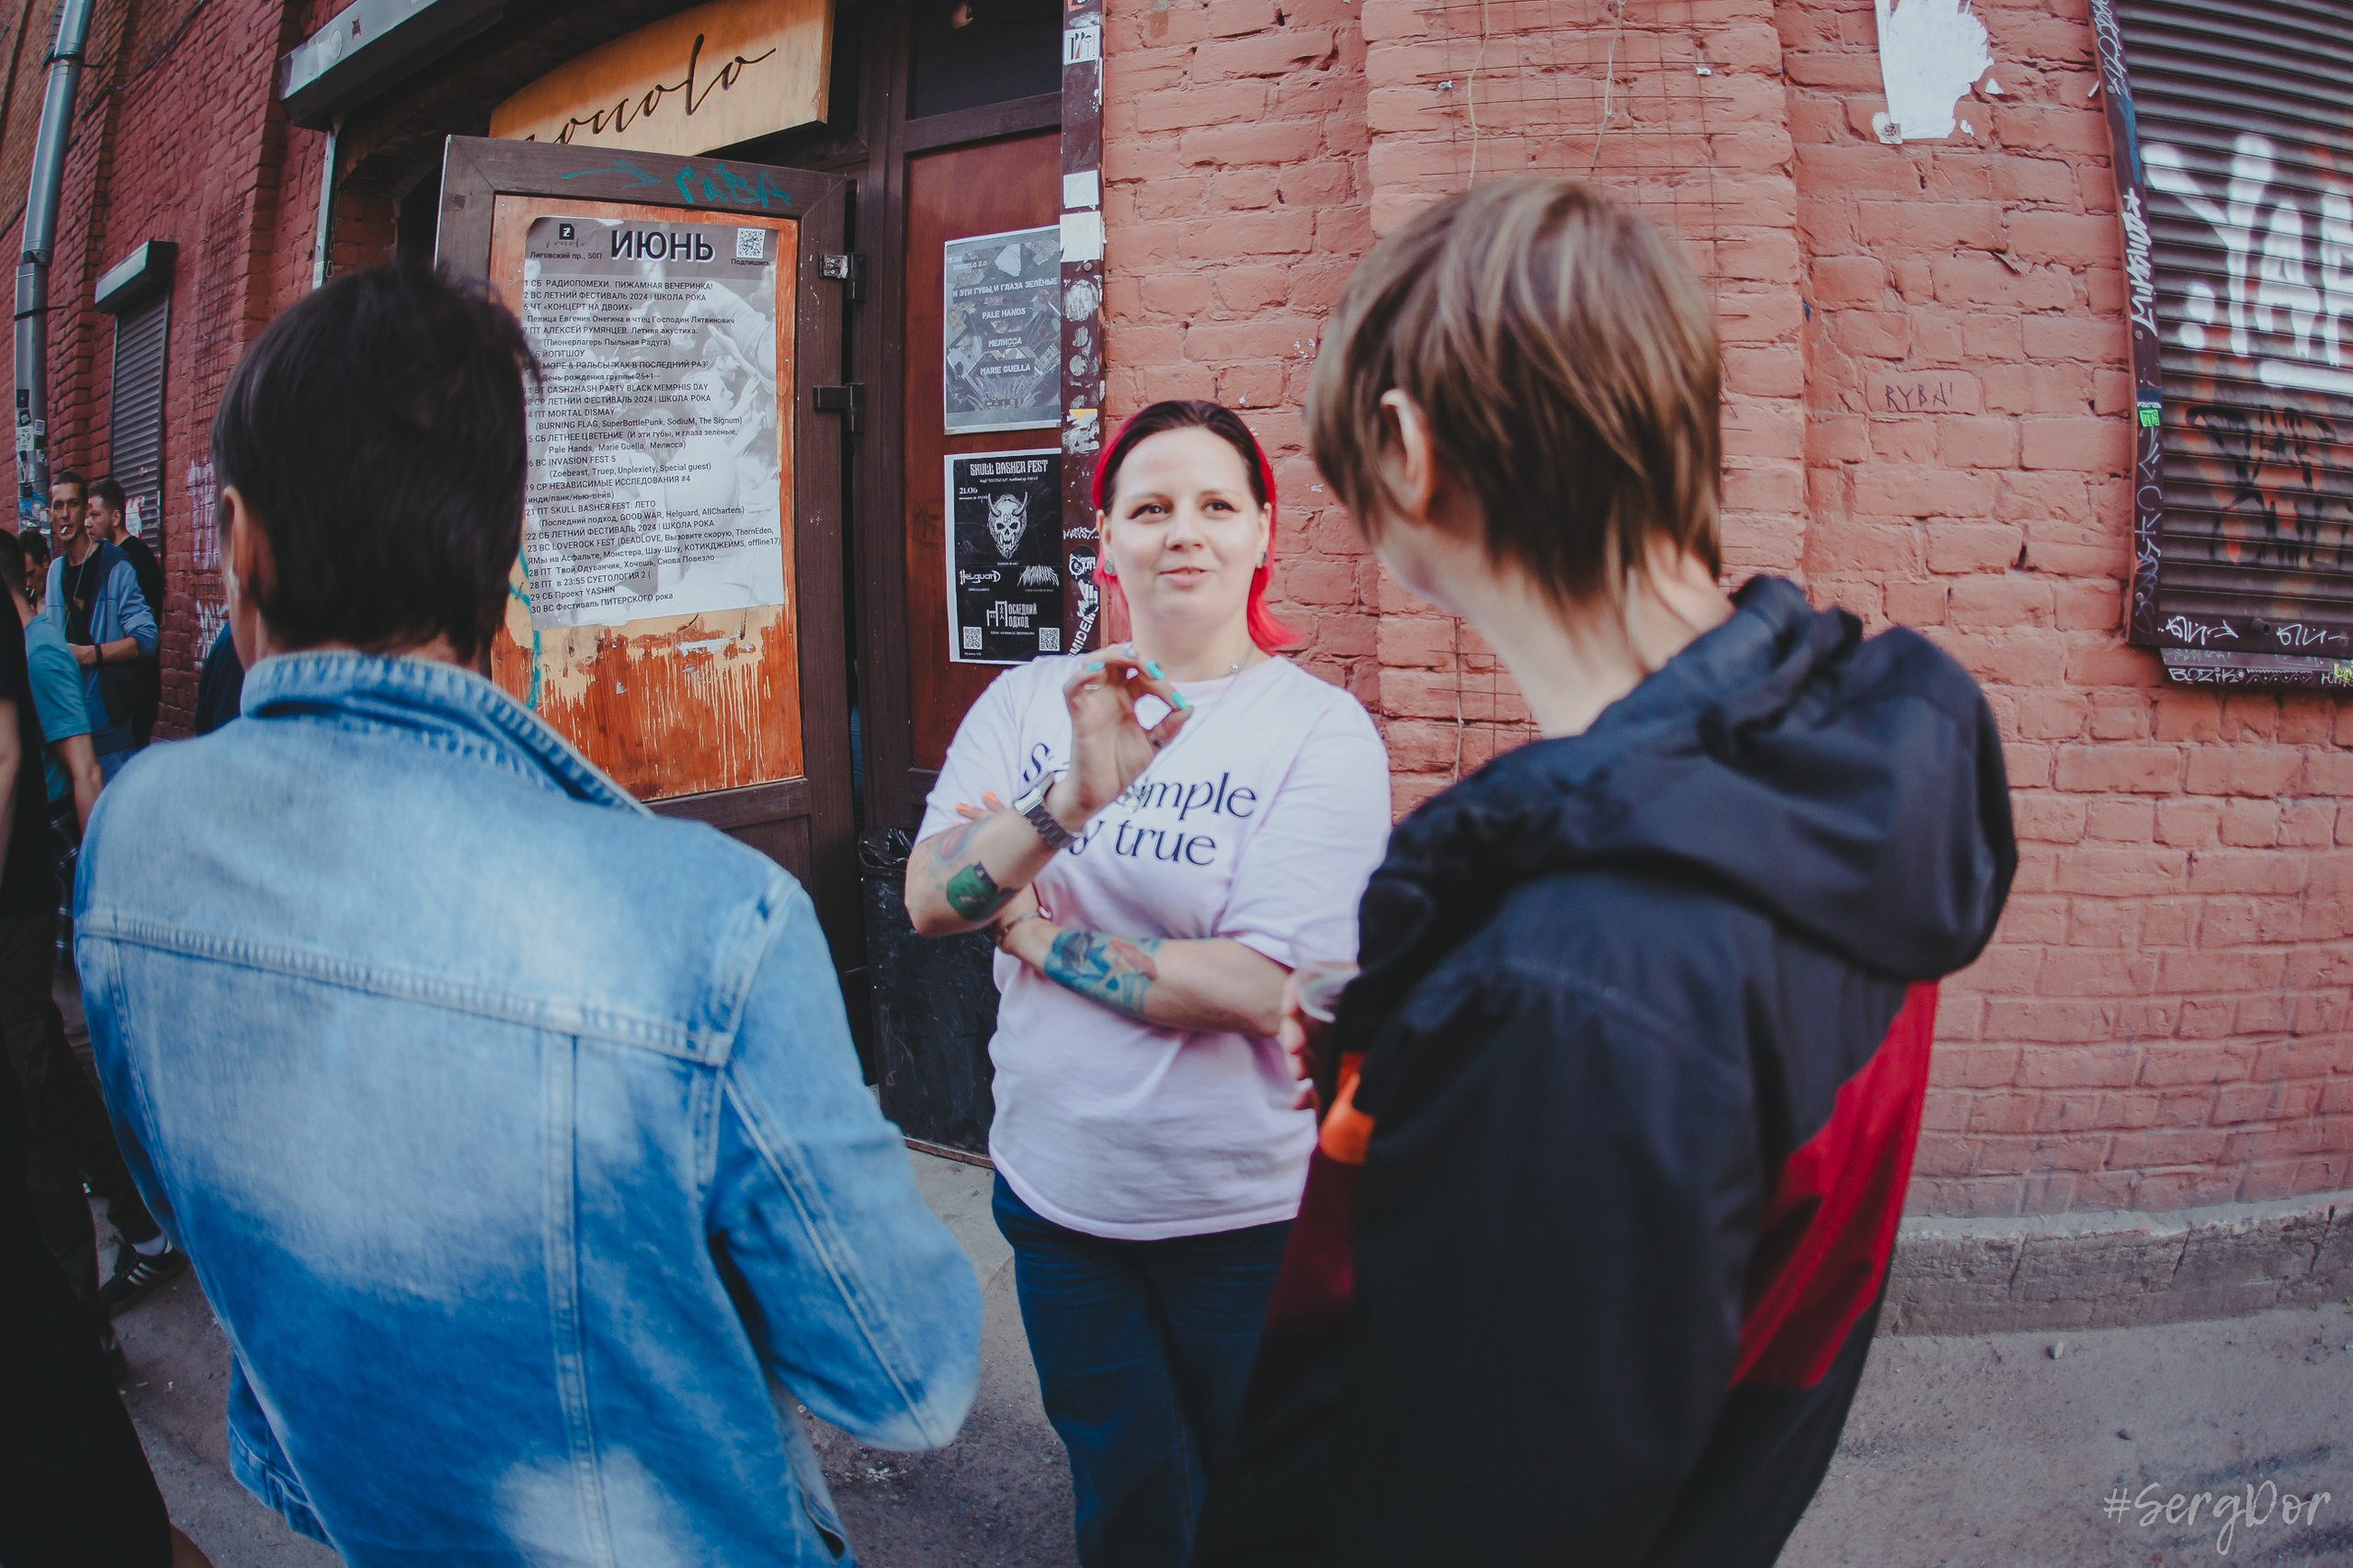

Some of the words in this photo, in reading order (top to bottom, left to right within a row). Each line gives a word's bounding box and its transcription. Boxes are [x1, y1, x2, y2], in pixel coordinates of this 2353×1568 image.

[525, 33, 777, 145] occolo
[611, 230, 715, 262] ИЮНЬ
[529, 251, 571, 259] Лиговский
[572, 253, 586, 261] пр.,
[587, 252, 603, 260] 50П
[731, 257, 771, 268] Подпишись
[546, 280, 611, 290] РАДИОПОМЕХИ.
[615, 281, 663, 290] ПИЖАМНАЯ
[665, 282, 713, 290] ВЕЧЕРИНКА!
[1001, 282, 1023, 290] ГЛАЗА
[1025, 278, 1057, 288] ЗЕЛЁНЫЕ
[544, 290, 577, 300] ЛЕТНИЙ
[579, 291, 628, 300] ФЕСТИВАЛЬ
[630, 292, 648, 301] 2024
[686, 293, 707, 301] РОКА
[527, 314, 557, 324] Певица
[592, 315, 624, 324] Онегина
[652, 316, 688, 325] Господин
[691, 316, 735, 324] Литвинович
[983, 311, 999, 319] PALE
[1002, 308, 1026, 317] HANDS
[543, 325, 582, 335] АЛЕКСЕЙ
[583, 326, 629, 335] РУМЯНЦЕВ.
[661, 328, 698, 336] акустика.
[543, 338, 602, 347] (Пионерлагерь
[605, 338, 639, 347] Пыльная
[641, 339, 671, 347] Радуга)
[989, 337, 1022, 347] МЕЛИССА
[981, 367, 1001, 375] MARIE
[1004, 364, 1030, 372] GUELLA
[564, 375, 605, 383] рождения
[606, 374, 634, 382] группы
[547, 385, 597, 393] CASH2HASH
[627, 384, 653, 392] BLACK
[654, 383, 691, 392] MEMPHIS
[693, 383, 709, 392] DAY
[547, 395, 582, 405] ЛЕТНИЙ
[584, 396, 632, 404] ФЕСТИВАЛЬ
[659, 395, 688, 403] ШКОЛА
[690, 394, 711, 403] РОКА
[548, 409, 583, 417] MORTAL
[585, 408, 616, 416] DISMAY
[536, 421, 575, 431] (BURNING
[577, 420, 600, 429] FLAG,
[602, 418, 665, 429] SuperBottlePunk,
[666, 417, 698, 427] SodiuM,
[699, 417, 711, 426] The
[713, 416, 743, 426] Signum)
[548, 433, 580, 442] ЛЕТНЕЕ
[582, 432, 623, 442] ЦВЕТЕНИЕ
[653, 432, 673, 440] губы,
[549, 445, 566, 453] Pale
[567, 444, 595, 454] Hands,
[598, 443, 619, 451] Marie
[620, 443, 646, 452] Guella,
[650, 441, 687, 451] Мелисса)
[549, 457, 588, 466] INVASION
[590, 456, 609, 464] FEST
[550, 468, 590, 478] (Zoebeast,
[592, 467, 616, 477] Truep,
[659, 464, 687, 474] Special
[688, 462, 711, 472] guest)
[970, 463, 994, 475] SKULL
[995, 461, 1026, 474] BASHER
[1028, 460, 1048, 472] FEST
[550, 479, 613, 490] НЕЗАВИСИМЫЕ
[615, 475, 680, 488] ИССЛЕДОВАНИЯ
[551, 505, 576, 514] SKULL
[578, 503, 610, 512] BASHER
[611, 501, 633, 510] FEST:
[634, 500, 656, 508] ЛЕТО
[539, 516, 586, 528] (Последний
[620, 512, 642, 521] GOOD
[643, 511, 664, 521] WAR,
[665, 509, 700, 520] Helguard,
[701, 506, 745, 517] AllCharters)
[539, 530, 550, 540] СБ
[551, 527, 585, 539] ЛЕТНИЙ
[586, 525, 636, 536] ФЕСТИВАЛЬ
[638, 523, 656, 532] 2024
[663, 521, 692, 530] ШКОЛА
[694, 519, 715, 528] РОКА
[527, 544, 538, 552] 23
[539, 543, 550, 551] ВС
[552, 540, 596, 551] LOVEROCK
[597, 538, 616, 547] FEST
[617, 535, 664, 547] (DEADLOVE,
[665, 531, 702, 542] Вызовите
[703, 531, 734, 540] скорую,
[735, 527, 774, 539] ThornEden,
[528, 555, 548, 564] ЯМы
[561, 551, 602, 563] Асфальте,
[604, 548, 644, 561] Монстера,
[529, 568, 540, 577] 28
[540, 567, 551, 575] ПТ
[556, 565, 576, 574] Твой
[577, 562, 620, 574] Одуванчик,
[623, 558, 655, 570] Хочешь,
[657, 556, 681, 566] Снова
[682, 553, 715, 563] Повезло
[529, 580, 540, 589] 28
[541, 579, 552, 588] ПТ
[563, 576, 585, 586] 23:55
[586, 572, 640, 584] СУЕТОЛОГИЯ
[641, 571, 646, 579] 2
[529, 592, 540, 600] 29
[541, 591, 553, 599] СБ
[555, 588, 584, 599] Проект
[585, 585, 616, 596] YASHIN
[530, 604, 541, 613] 30
[542, 603, 554, 612] ВС
[556, 599, 599, 610] Фестиваль
[600, 594, 653, 607] ПИТЕРСКОГО
[654, 594, 674, 603] рока
[1115, 820, 1215, 865] true
